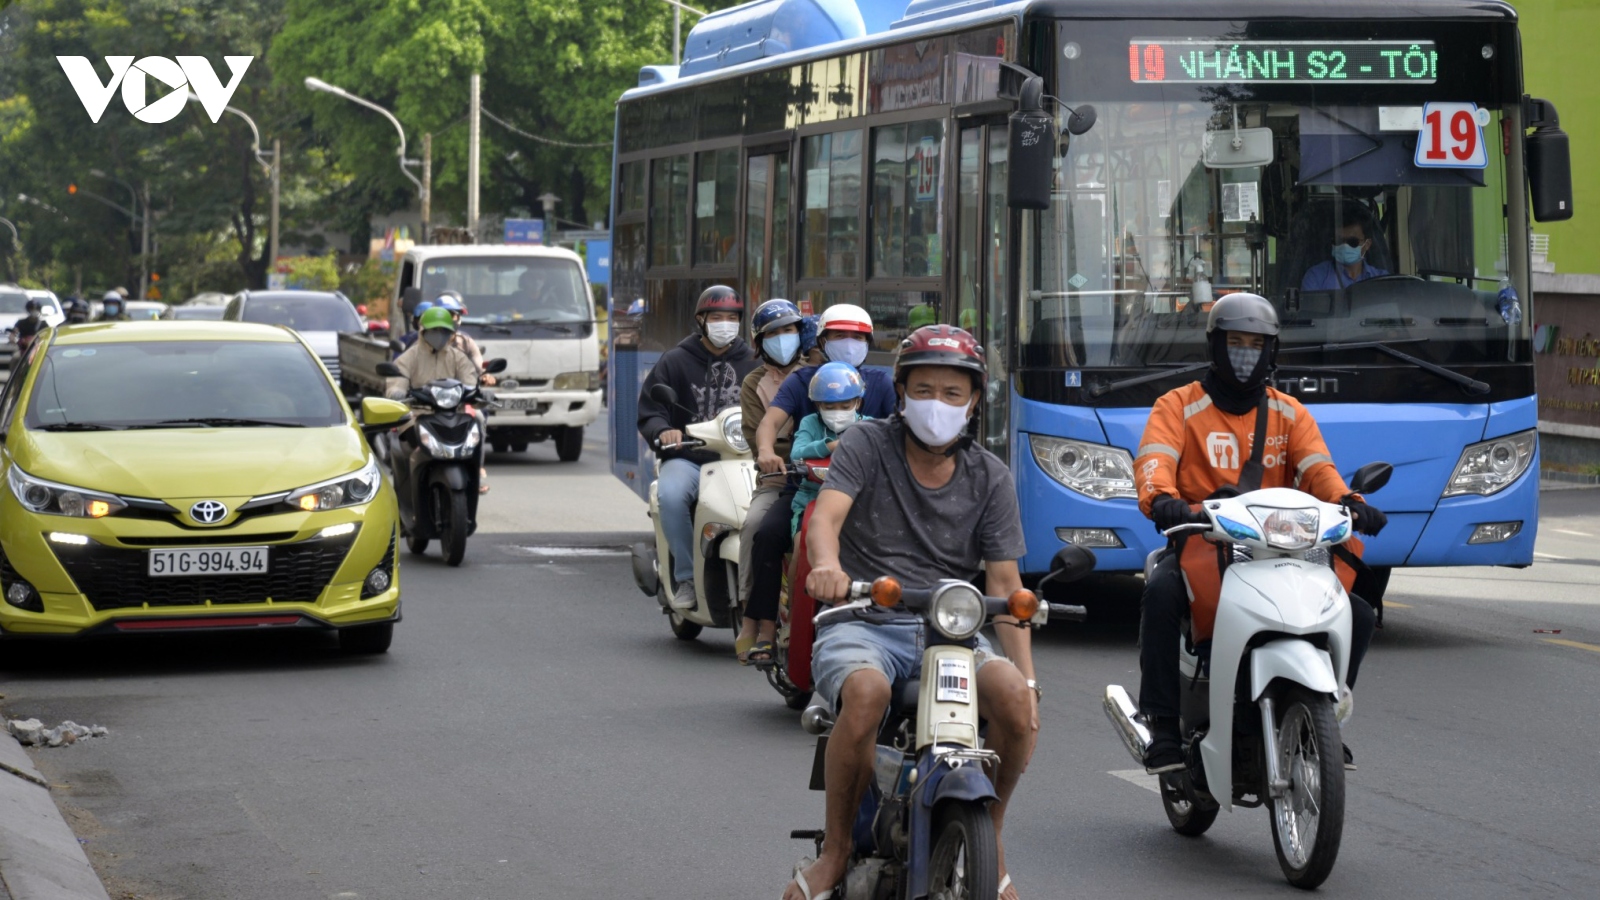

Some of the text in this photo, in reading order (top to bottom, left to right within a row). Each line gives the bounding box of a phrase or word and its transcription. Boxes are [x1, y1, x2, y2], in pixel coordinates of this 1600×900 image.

[1129, 44, 1165, 80] 19
[1180, 44, 1294, 78] NHÁNH
[1307, 51, 1347, 78] S2
[1426, 110, 1476, 161] 19
[916, 147, 933, 194] 19
[153, 551, 264, 573] 51G-994.94
